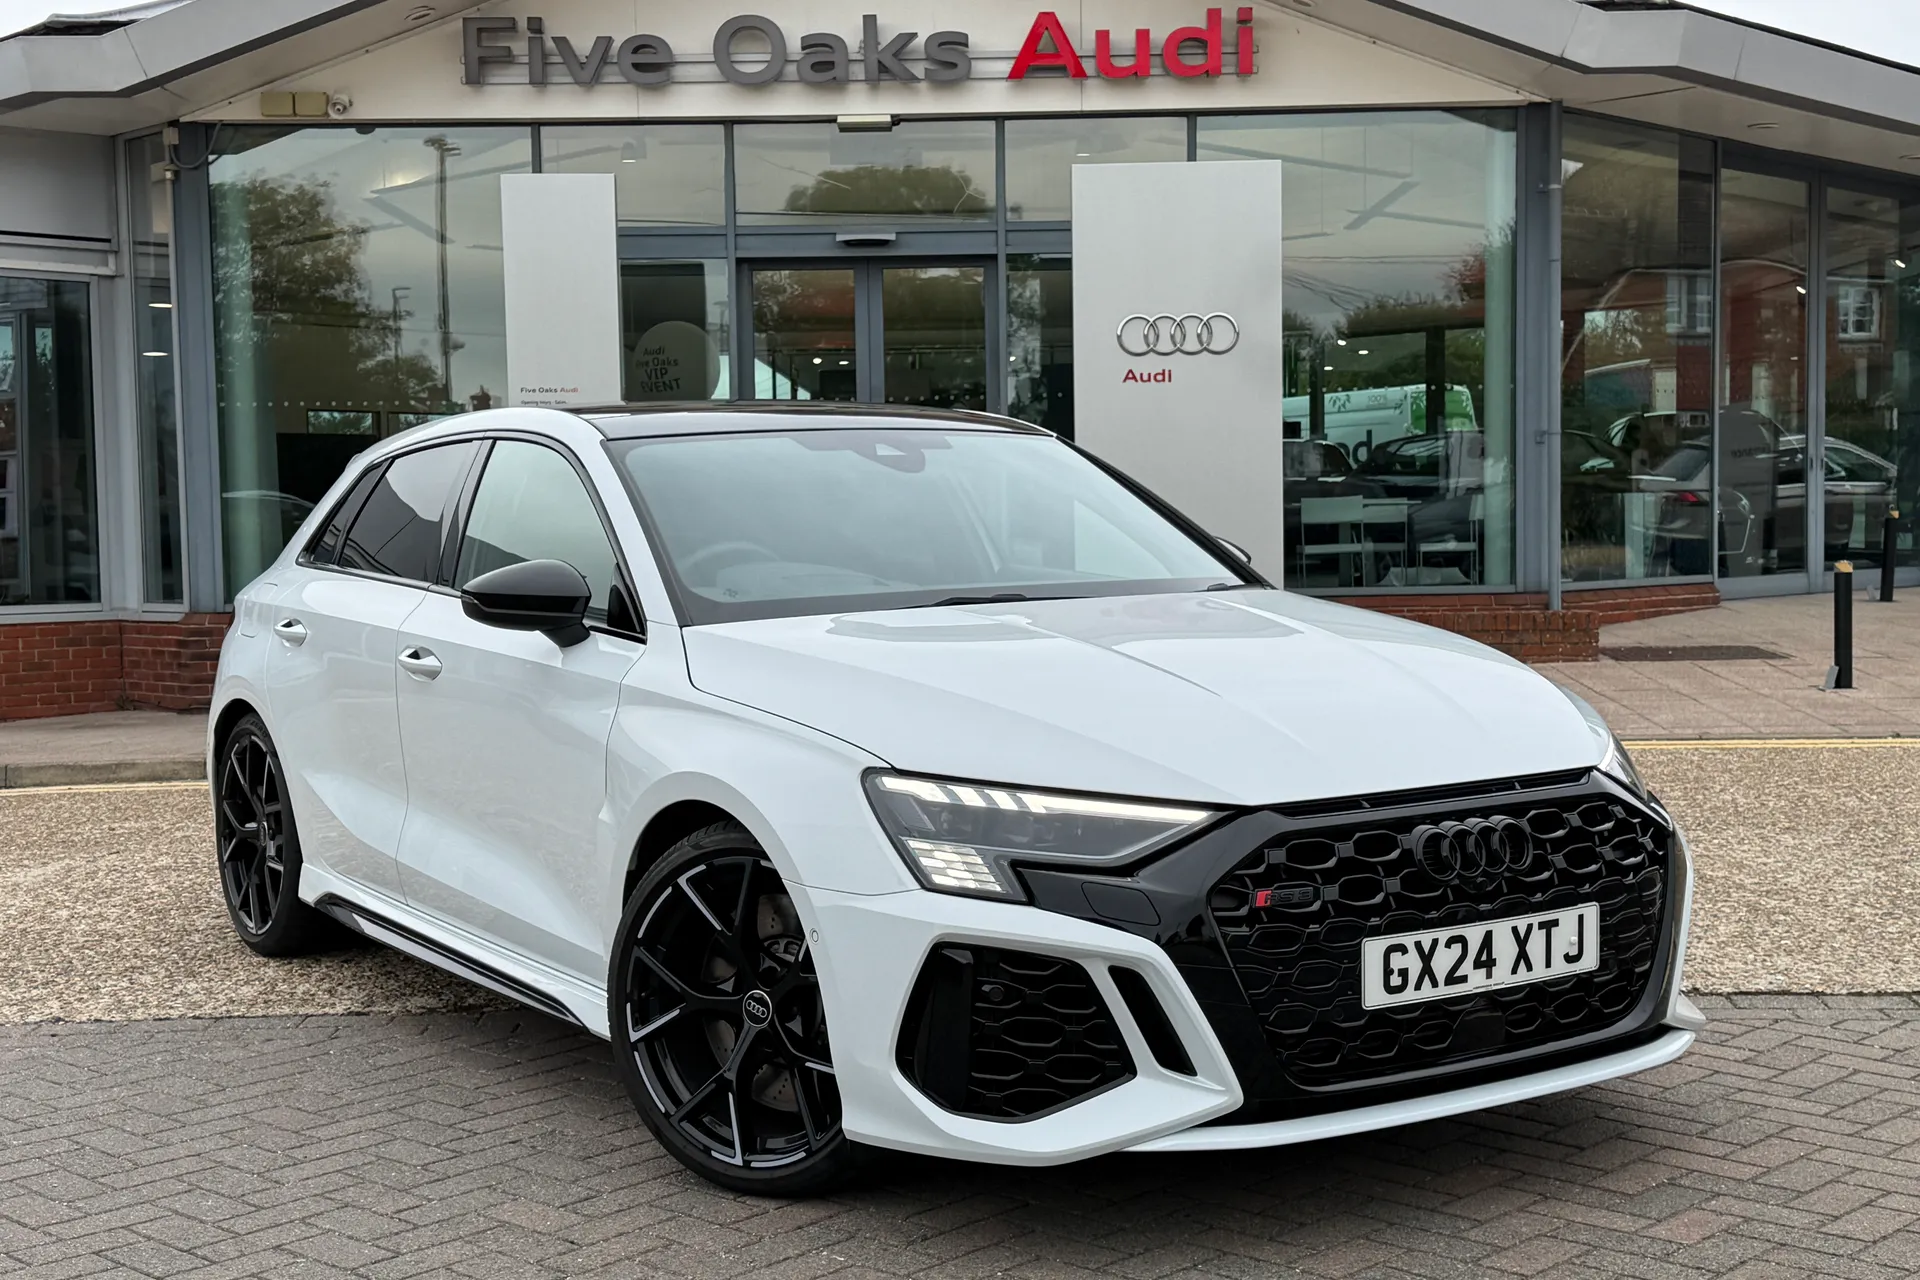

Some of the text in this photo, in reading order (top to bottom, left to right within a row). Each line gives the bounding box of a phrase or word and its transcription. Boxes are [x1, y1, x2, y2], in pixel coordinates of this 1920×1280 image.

[463, 7, 1254, 86] Five Oaks Audi
[643, 346, 665, 356] Audi
[652, 356, 678, 367] Oaks
[644, 367, 668, 380] VIP
[1122, 369, 1172, 383] Audi
[640, 377, 681, 392] EVENT
[1383, 913, 1585, 995] GX24 XTJ
